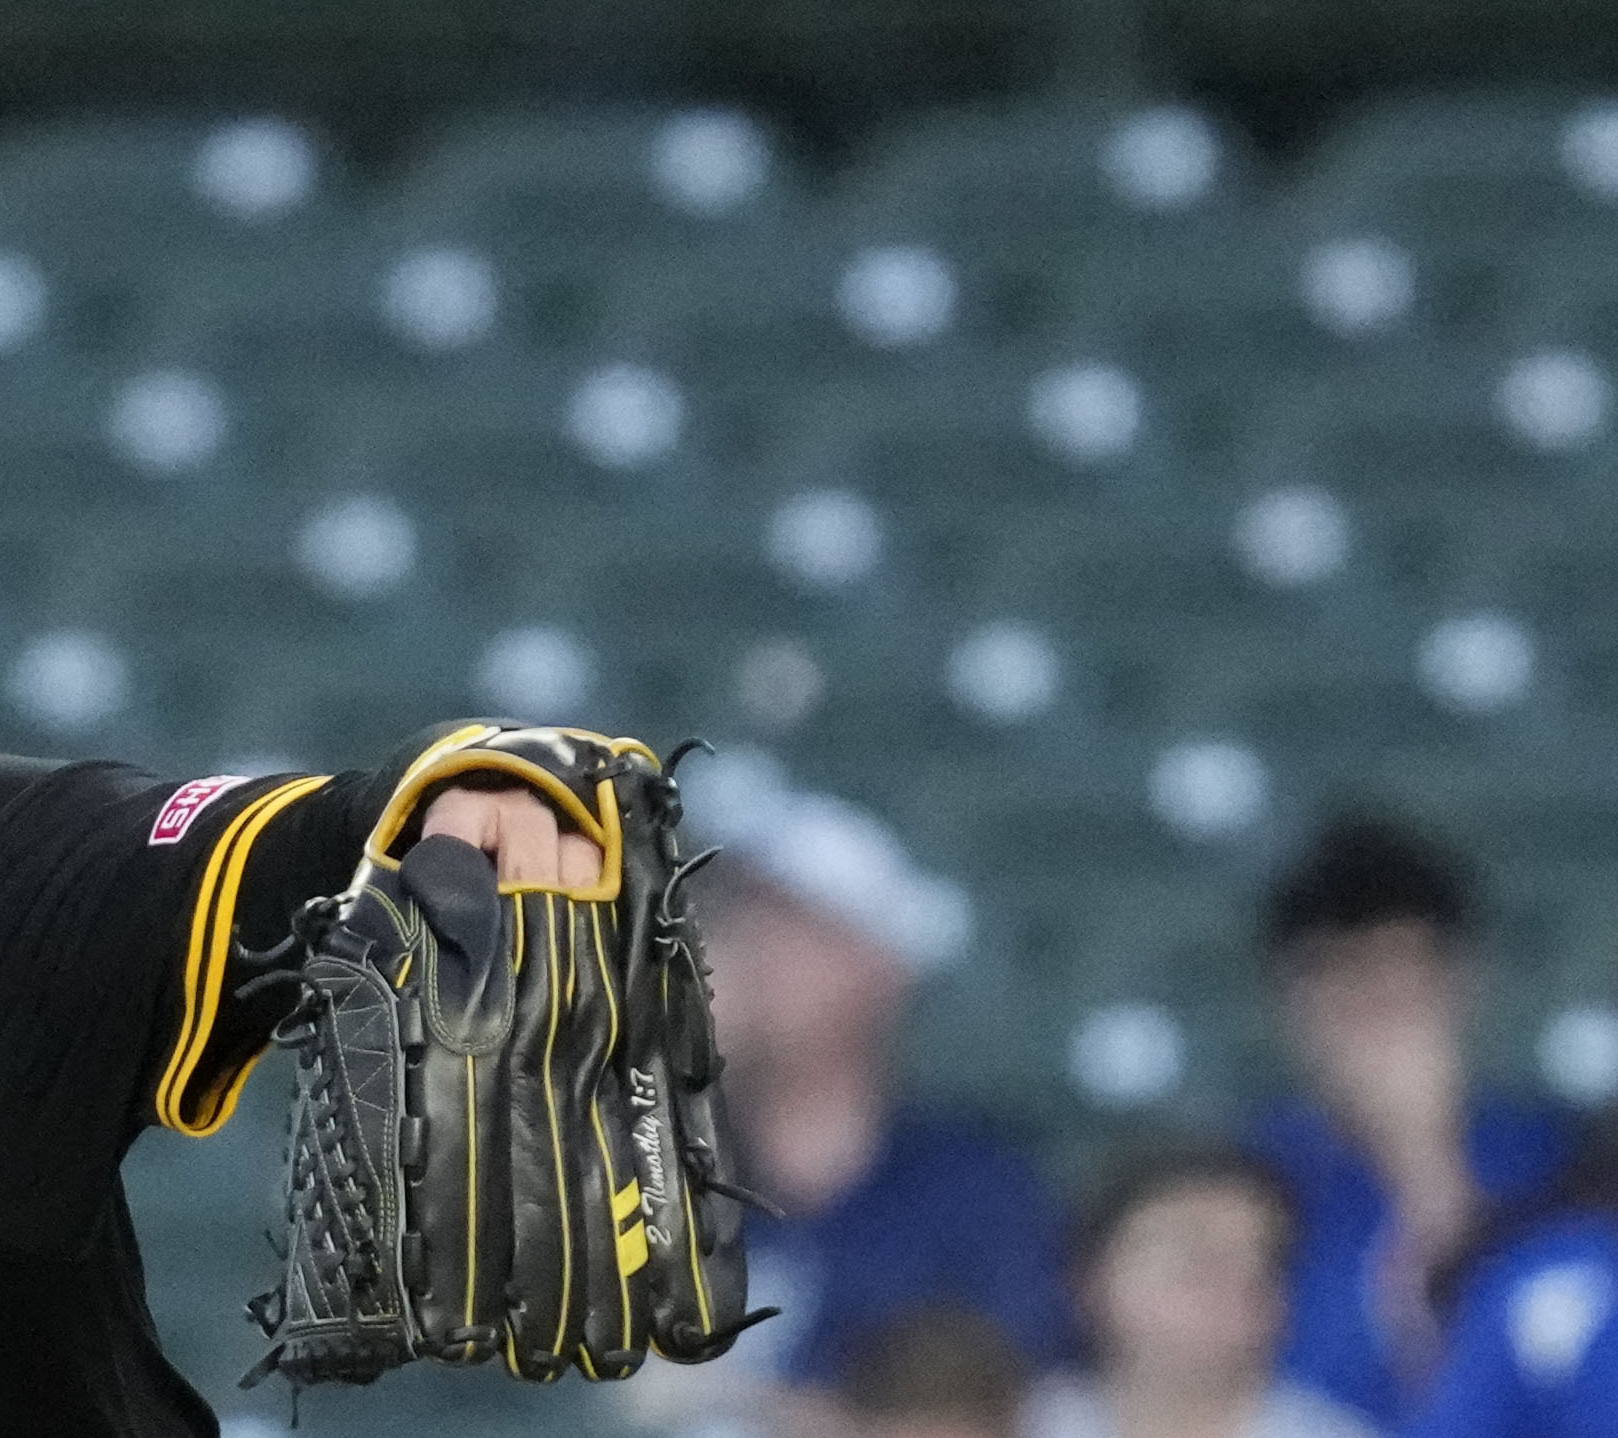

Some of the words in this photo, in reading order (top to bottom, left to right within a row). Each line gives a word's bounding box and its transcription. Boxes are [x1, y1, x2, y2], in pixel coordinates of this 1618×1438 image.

[629, 1066, 657, 1107] 1:7
[631, 1113, 669, 1217] Timothy
[646, 1224, 673, 1247] 2
